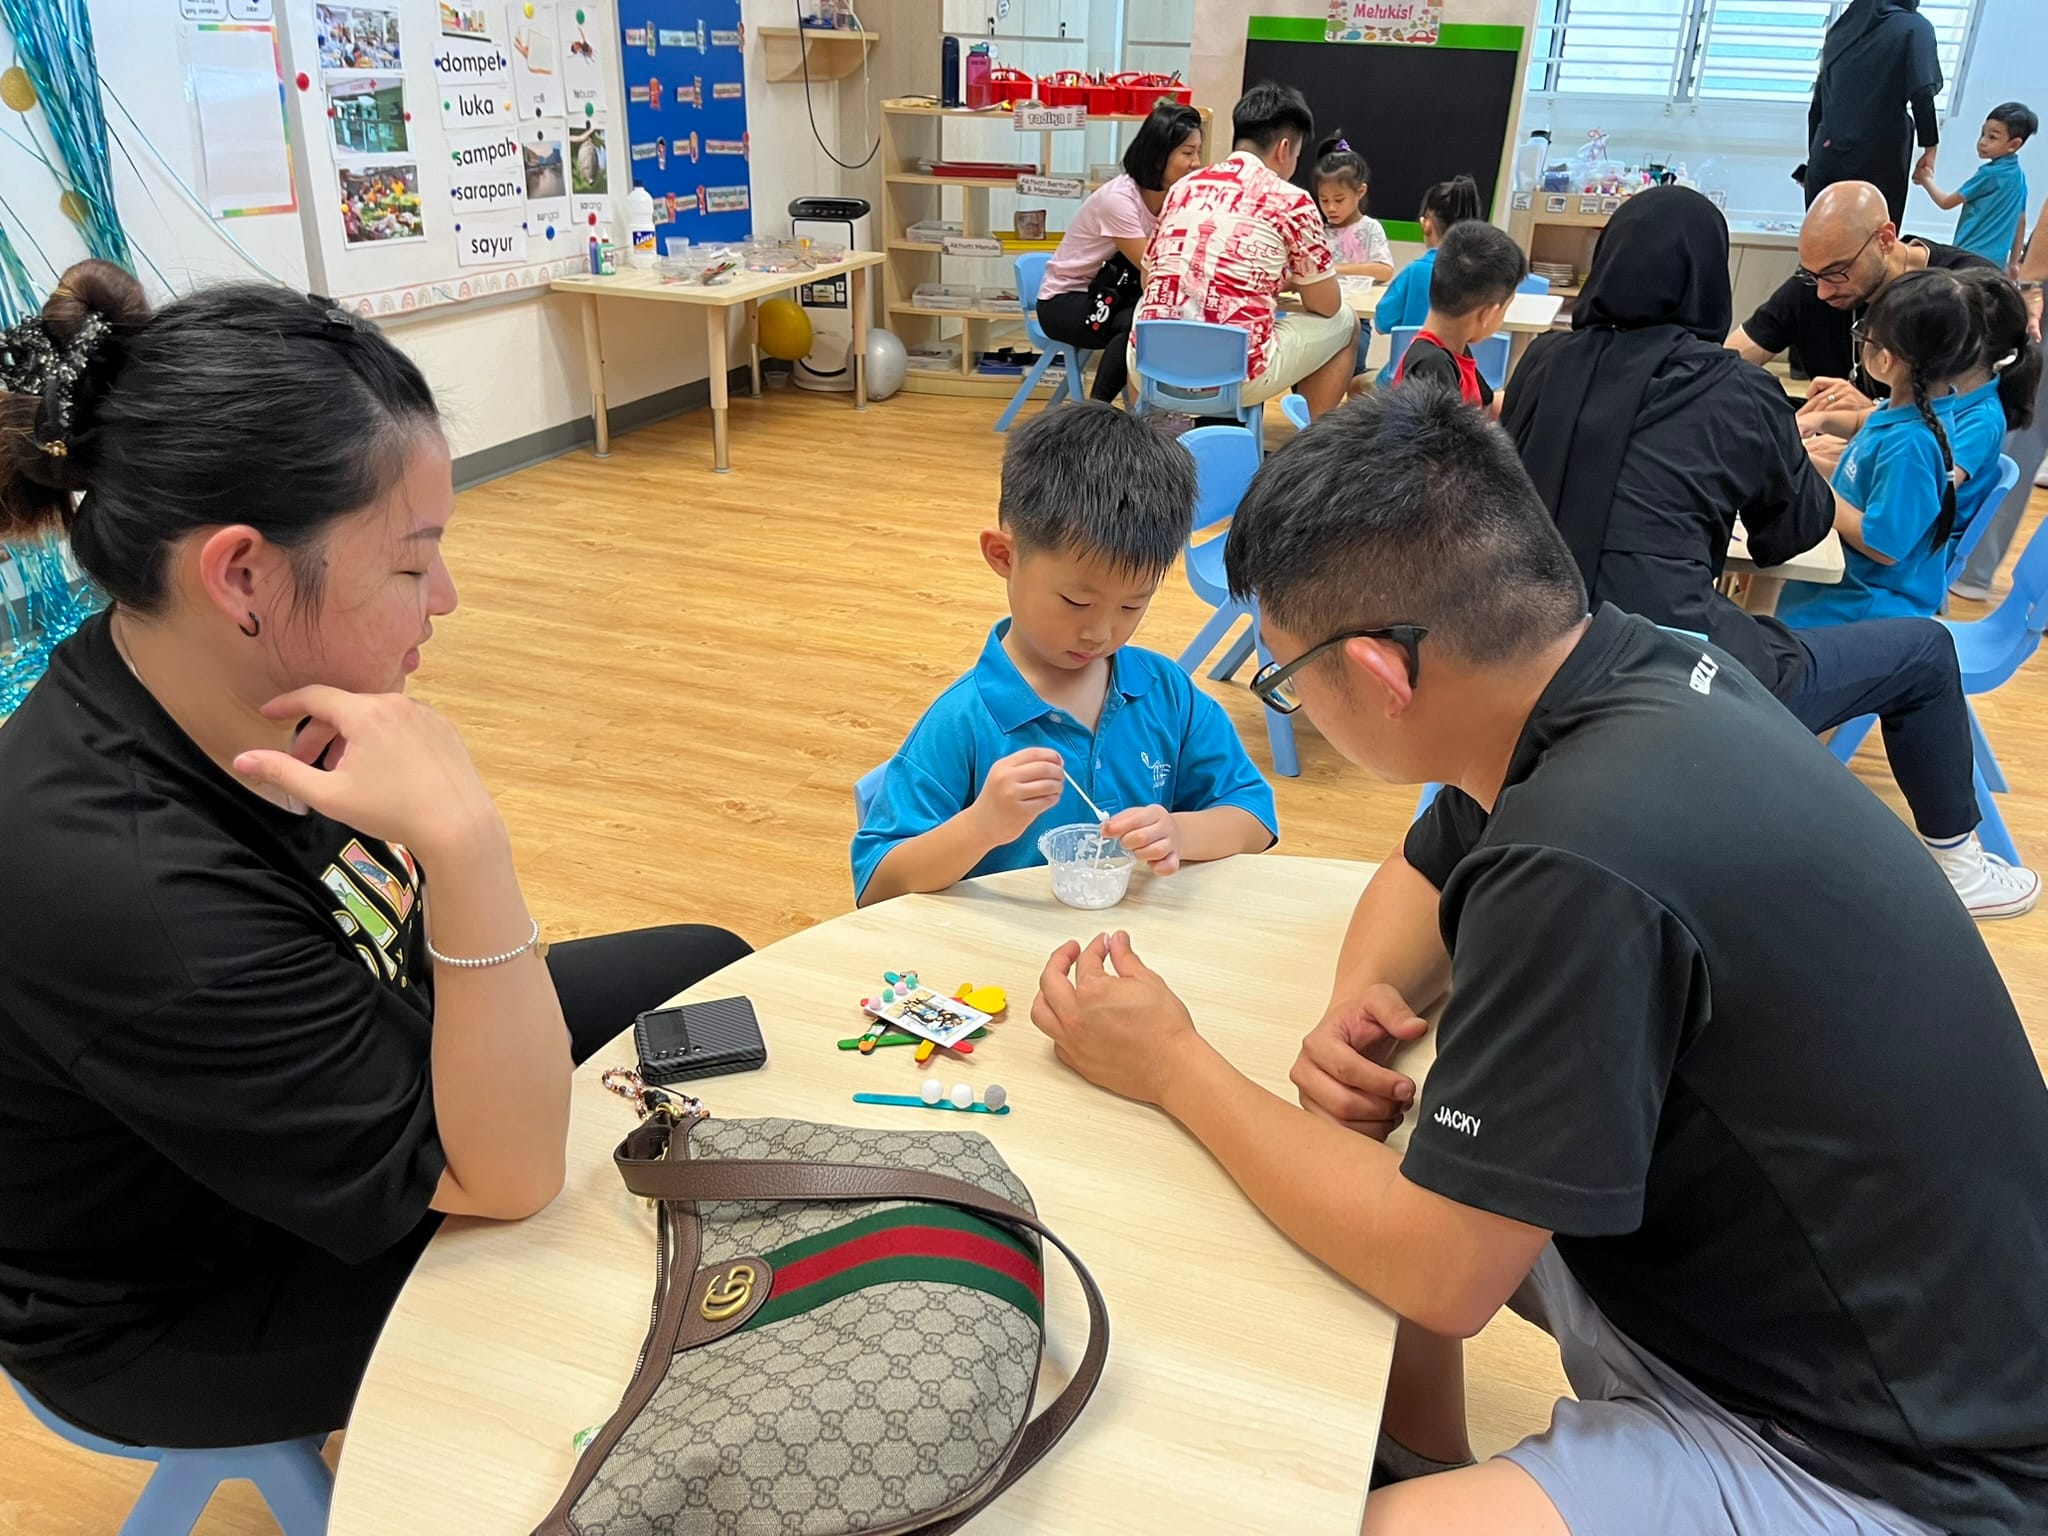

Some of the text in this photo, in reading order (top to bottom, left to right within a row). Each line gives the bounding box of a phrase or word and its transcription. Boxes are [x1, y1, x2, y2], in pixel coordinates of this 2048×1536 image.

[1353, 3, 1413, 20] Melukis!
[440, 50, 501, 76] dompet
[459, 93, 494, 116] luka
[456, 136, 515, 166] sampah
[457, 182, 514, 203] sarapan
[472, 237, 512, 258] sayur
[1434, 1105, 1481, 1137] JACKY
